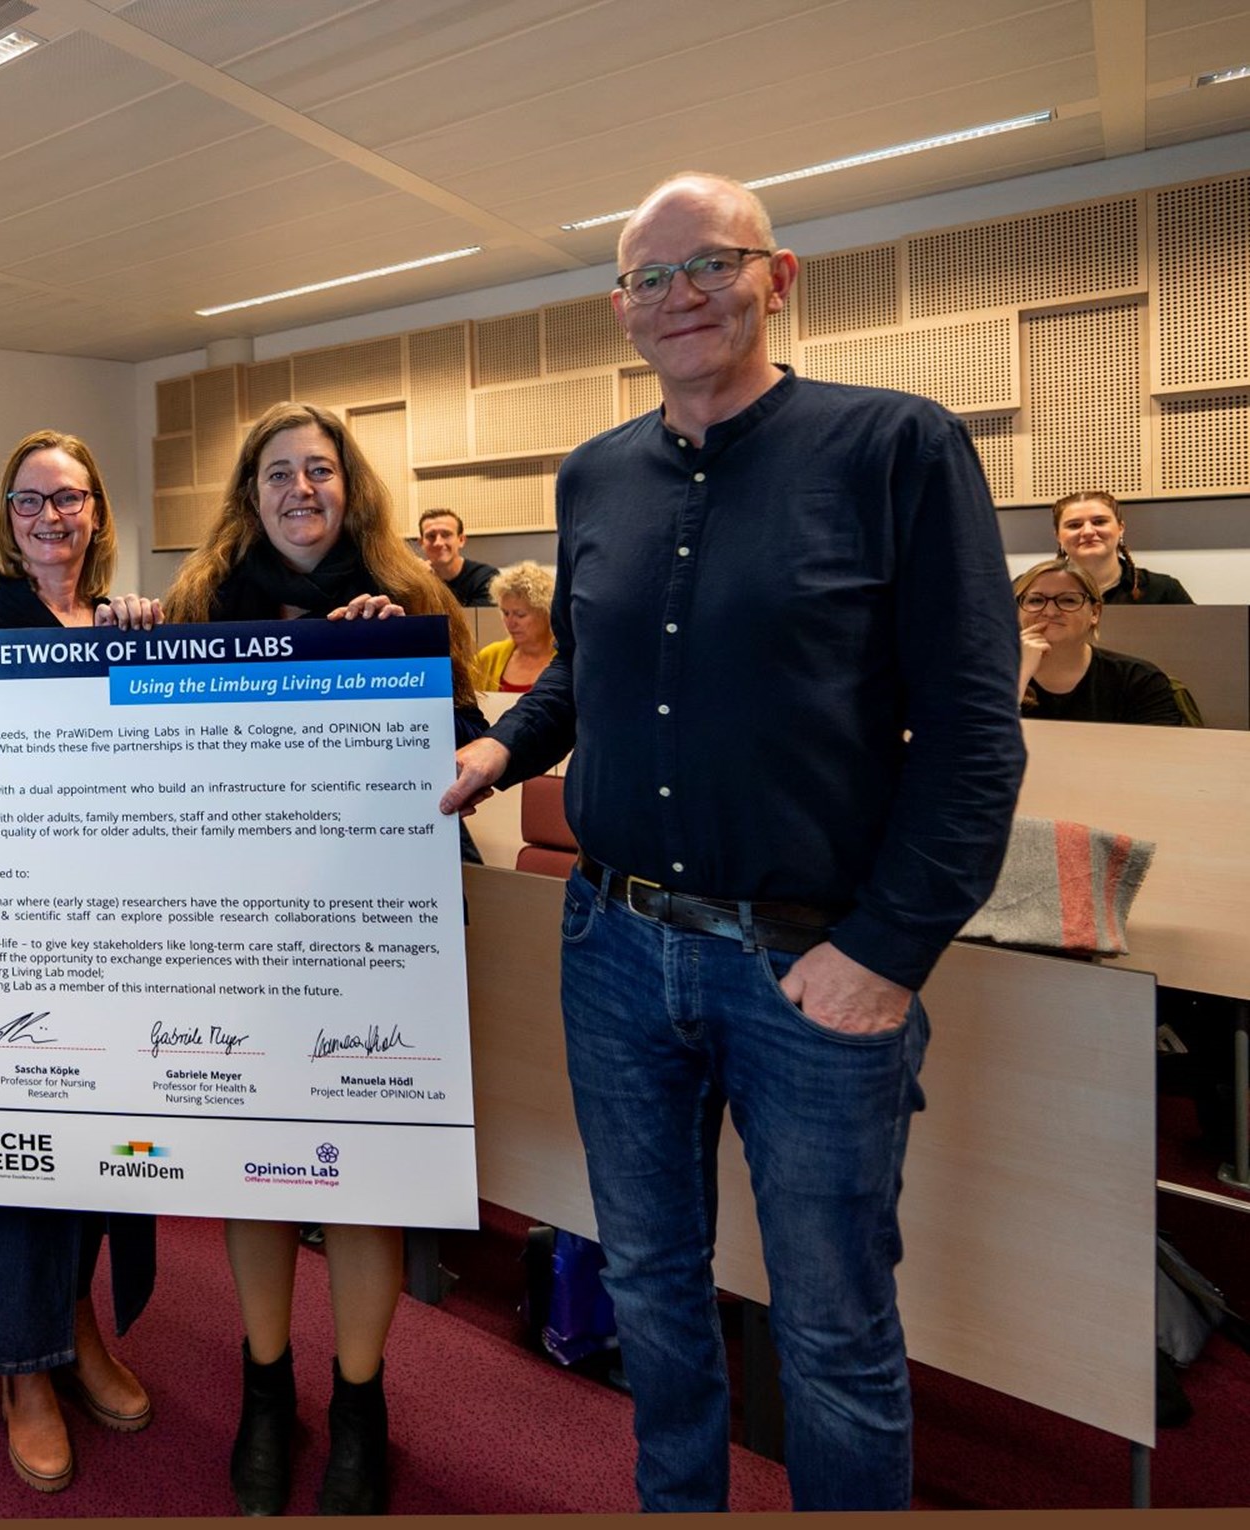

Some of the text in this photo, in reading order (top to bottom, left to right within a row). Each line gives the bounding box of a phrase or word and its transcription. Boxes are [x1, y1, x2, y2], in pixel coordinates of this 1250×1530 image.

[105, 642, 136, 662] OF
[145, 639, 225, 661] LIVING
[234, 637, 293, 658] LABS
[129, 672, 425, 698] Using the Limburg Living Lab model
[33, 729, 51, 739] the
[56, 728, 113, 738] PraWiDem
[118, 728, 149, 740] Living
[154, 727, 180, 737] Labs
[184, 727, 195, 736] in
[200, 726, 228, 736] Halle
[233, 726, 242, 736] &
[247, 725, 296, 738] Cologne,
[301, 724, 323, 734] and
[328, 724, 380, 734] OPINION
[386, 723, 404, 733] lab
[16, 813, 44, 823] older
[46, 813, 83, 824] adults,
[85, 813, 119, 825] family
[121, 812, 176, 824] members,
[179, 812, 204, 822] staff
[206, 812, 228, 822] and
[231, 812, 262, 822] other
[264, 811, 340, 823] stakeholders;
[15, 869, 29, 878] to:
[11, 967, 42, 979] Living
[44, 967, 64, 977] Lab
[66, 968, 104, 979] model;
[14, 1064, 79, 1078] Sascha Köpke
[165, 1069, 242, 1083] Gabriele Meyer
[0, 1076, 95, 1090] Professor for Nursing
[152, 1080, 256, 1093] Professor for Health &
[340, 1075, 413, 1086] Manuela Hödl
[27, 1088, 68, 1098] Research
[165, 1094, 244, 1106] Nursing Sciences
[310, 1087, 446, 1100] Project leader OPINION Lab
[99, 1160, 184, 1180] PraWiDem
[244, 1162, 339, 1177] Opinion Lab
